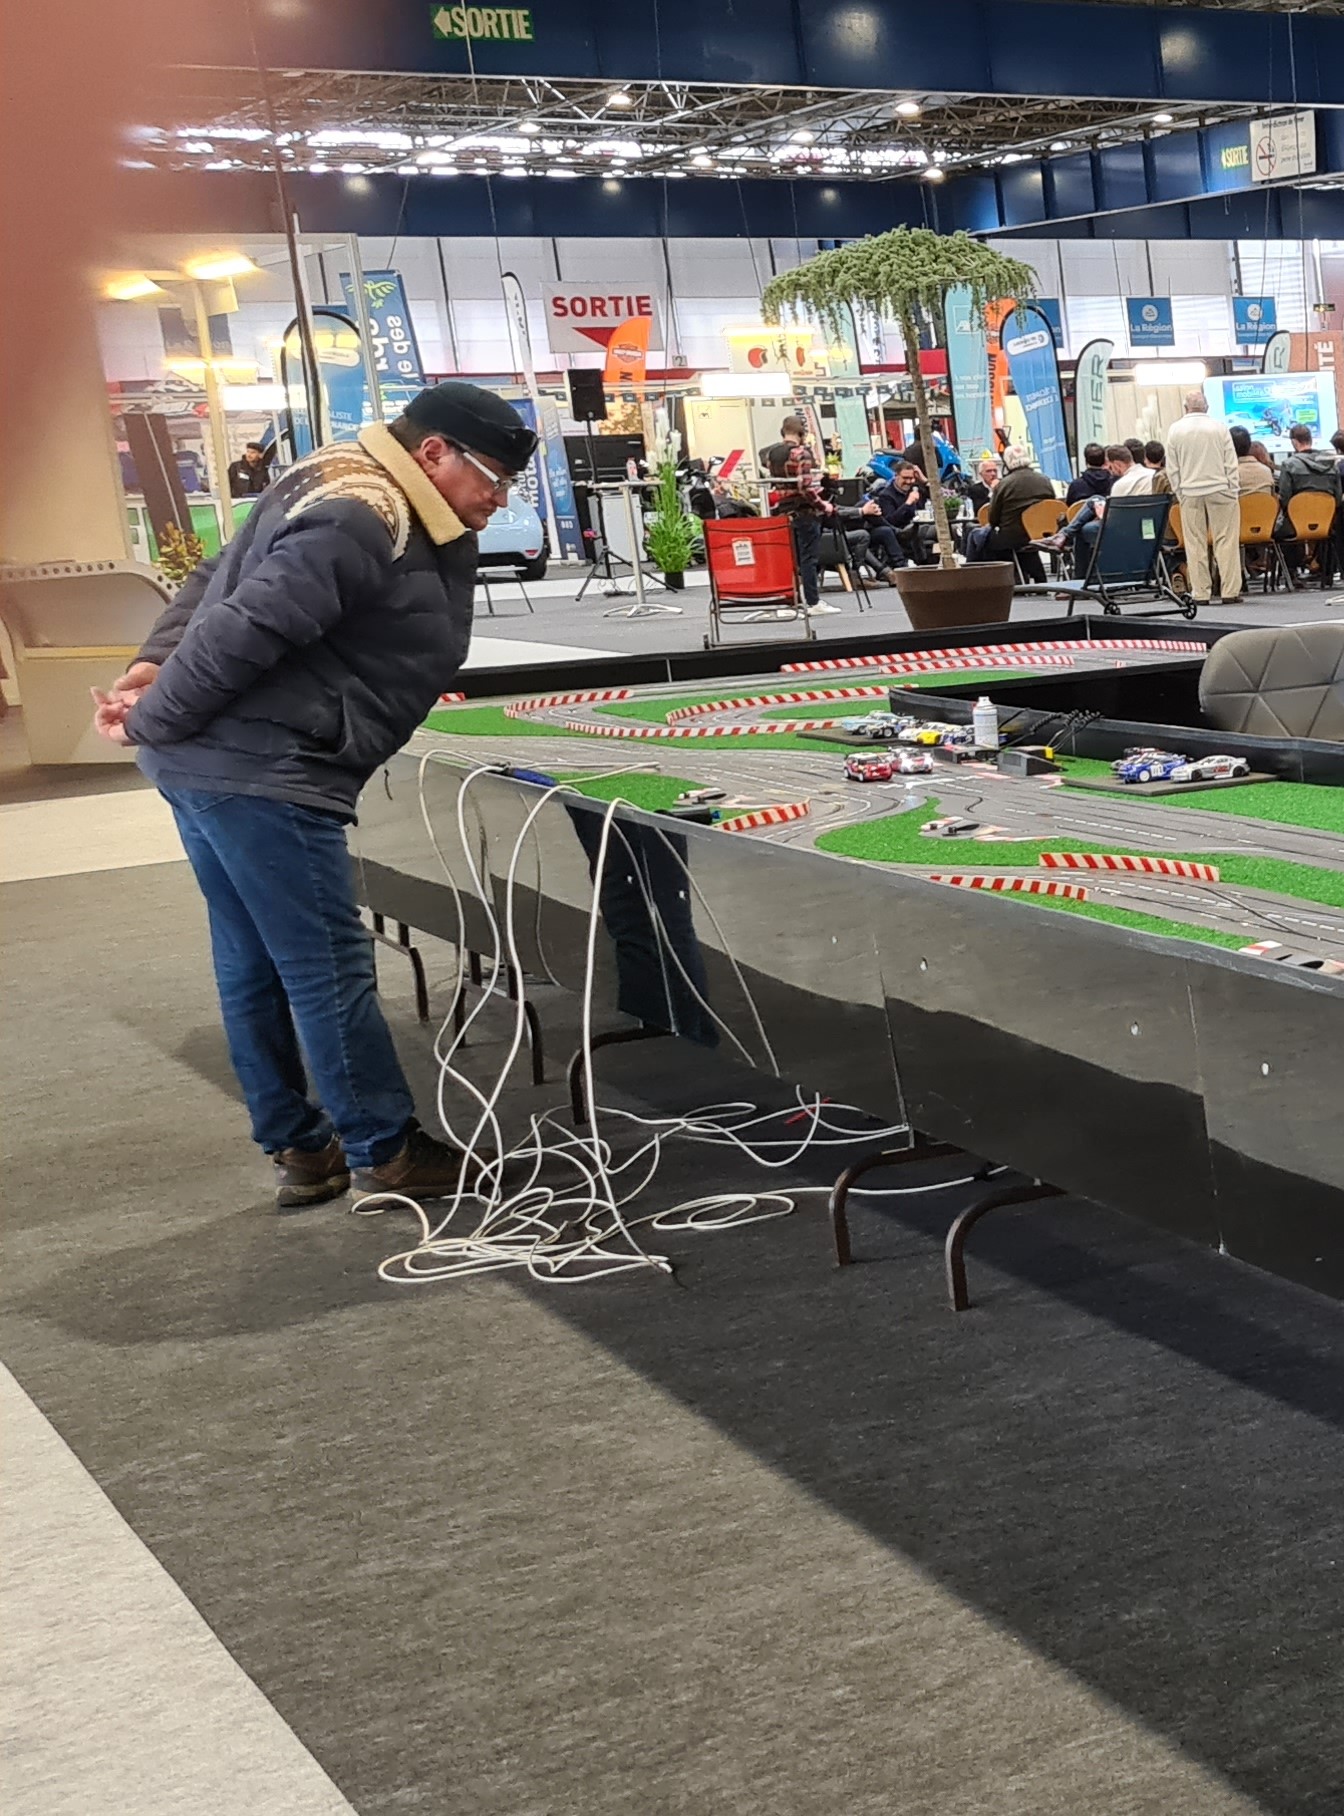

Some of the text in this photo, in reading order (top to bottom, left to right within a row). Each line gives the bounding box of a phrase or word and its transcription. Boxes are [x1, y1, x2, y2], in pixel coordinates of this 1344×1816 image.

[451, 7, 533, 39] SORTIE
[1225, 145, 1249, 168] SORTIE
[551, 295, 653, 318] SORTIE
[1142, 323, 1173, 334] Région
[1092, 354, 1104, 437] TIER
